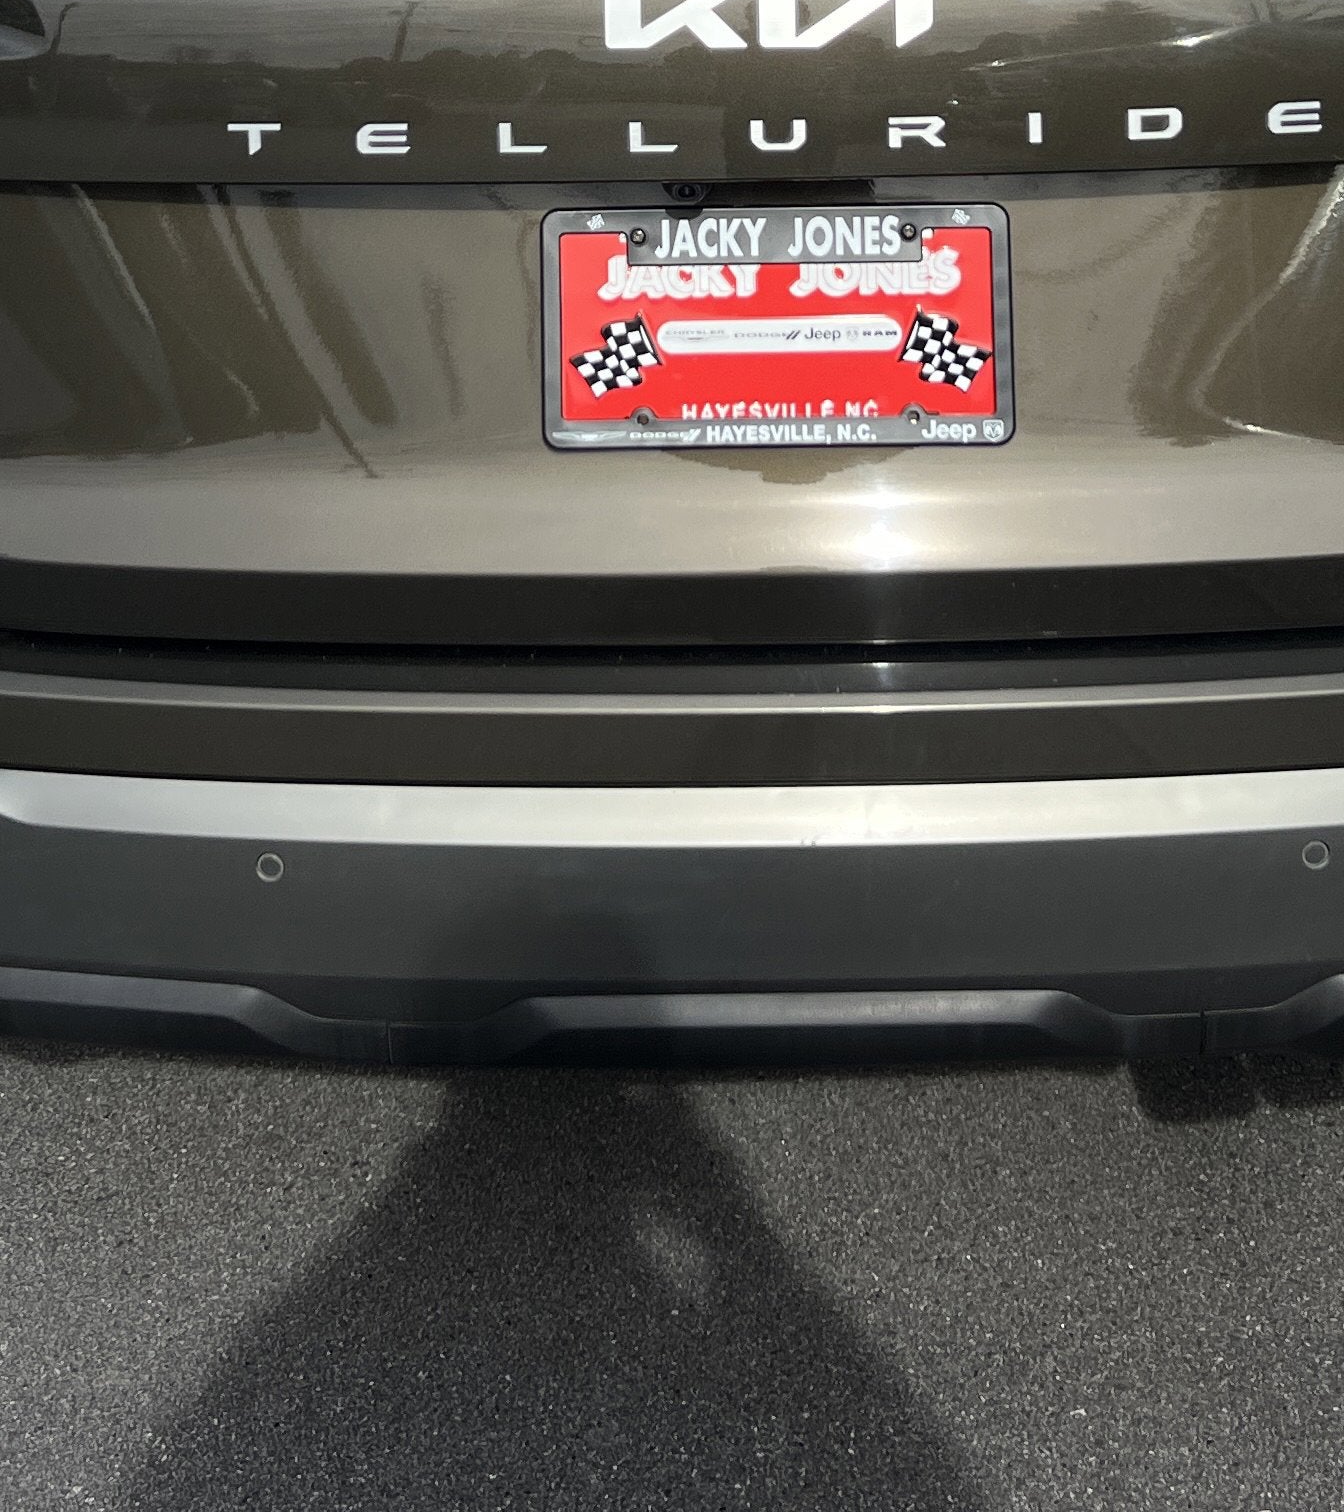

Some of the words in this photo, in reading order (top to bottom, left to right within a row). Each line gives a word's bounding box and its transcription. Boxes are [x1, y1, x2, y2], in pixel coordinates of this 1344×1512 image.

[227, 100, 1323, 155] TELLURIDE
[655, 217, 767, 258] JACKY
[788, 215, 901, 256] JONES
[597, 255, 761, 300] JACKY
[789, 245, 962, 297] JONES
[804, 327, 841, 342] Jeep
[862, 329, 897, 337] RAM
[706, 423, 831, 444] HAYESVILLE,
[837, 422, 878, 440] N.C.
[921, 419, 977, 442] Jeep
